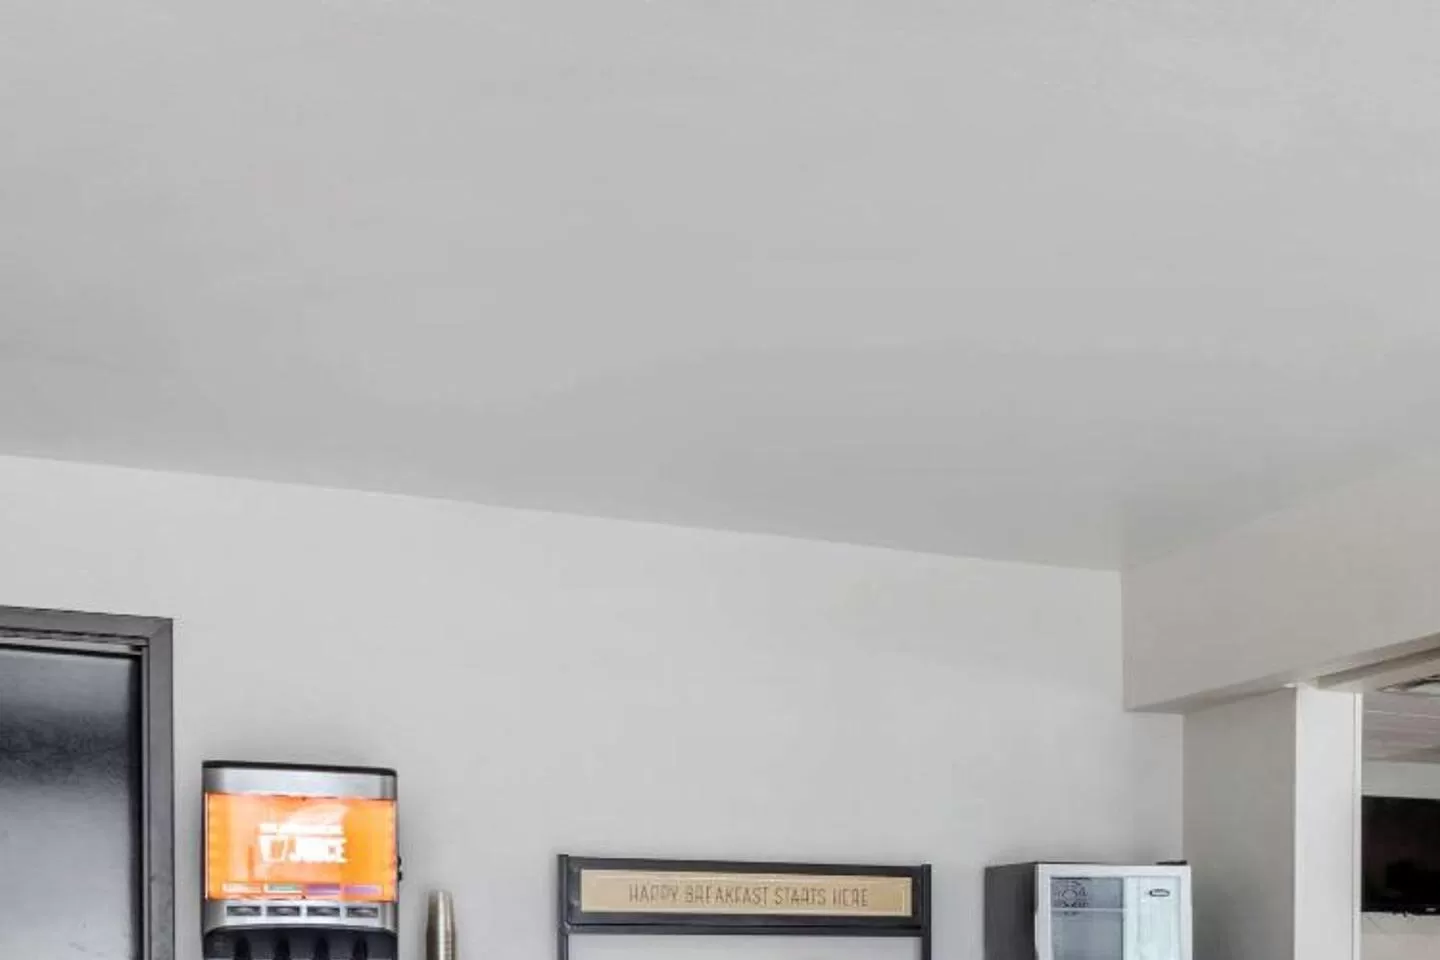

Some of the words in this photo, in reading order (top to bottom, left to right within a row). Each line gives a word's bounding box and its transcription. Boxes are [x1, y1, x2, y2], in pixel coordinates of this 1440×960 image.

[628, 883, 680, 904] HAPPY
[684, 885, 769, 906] BREAKFAST
[774, 886, 827, 906] STARTS
[831, 887, 869, 908] HERE
